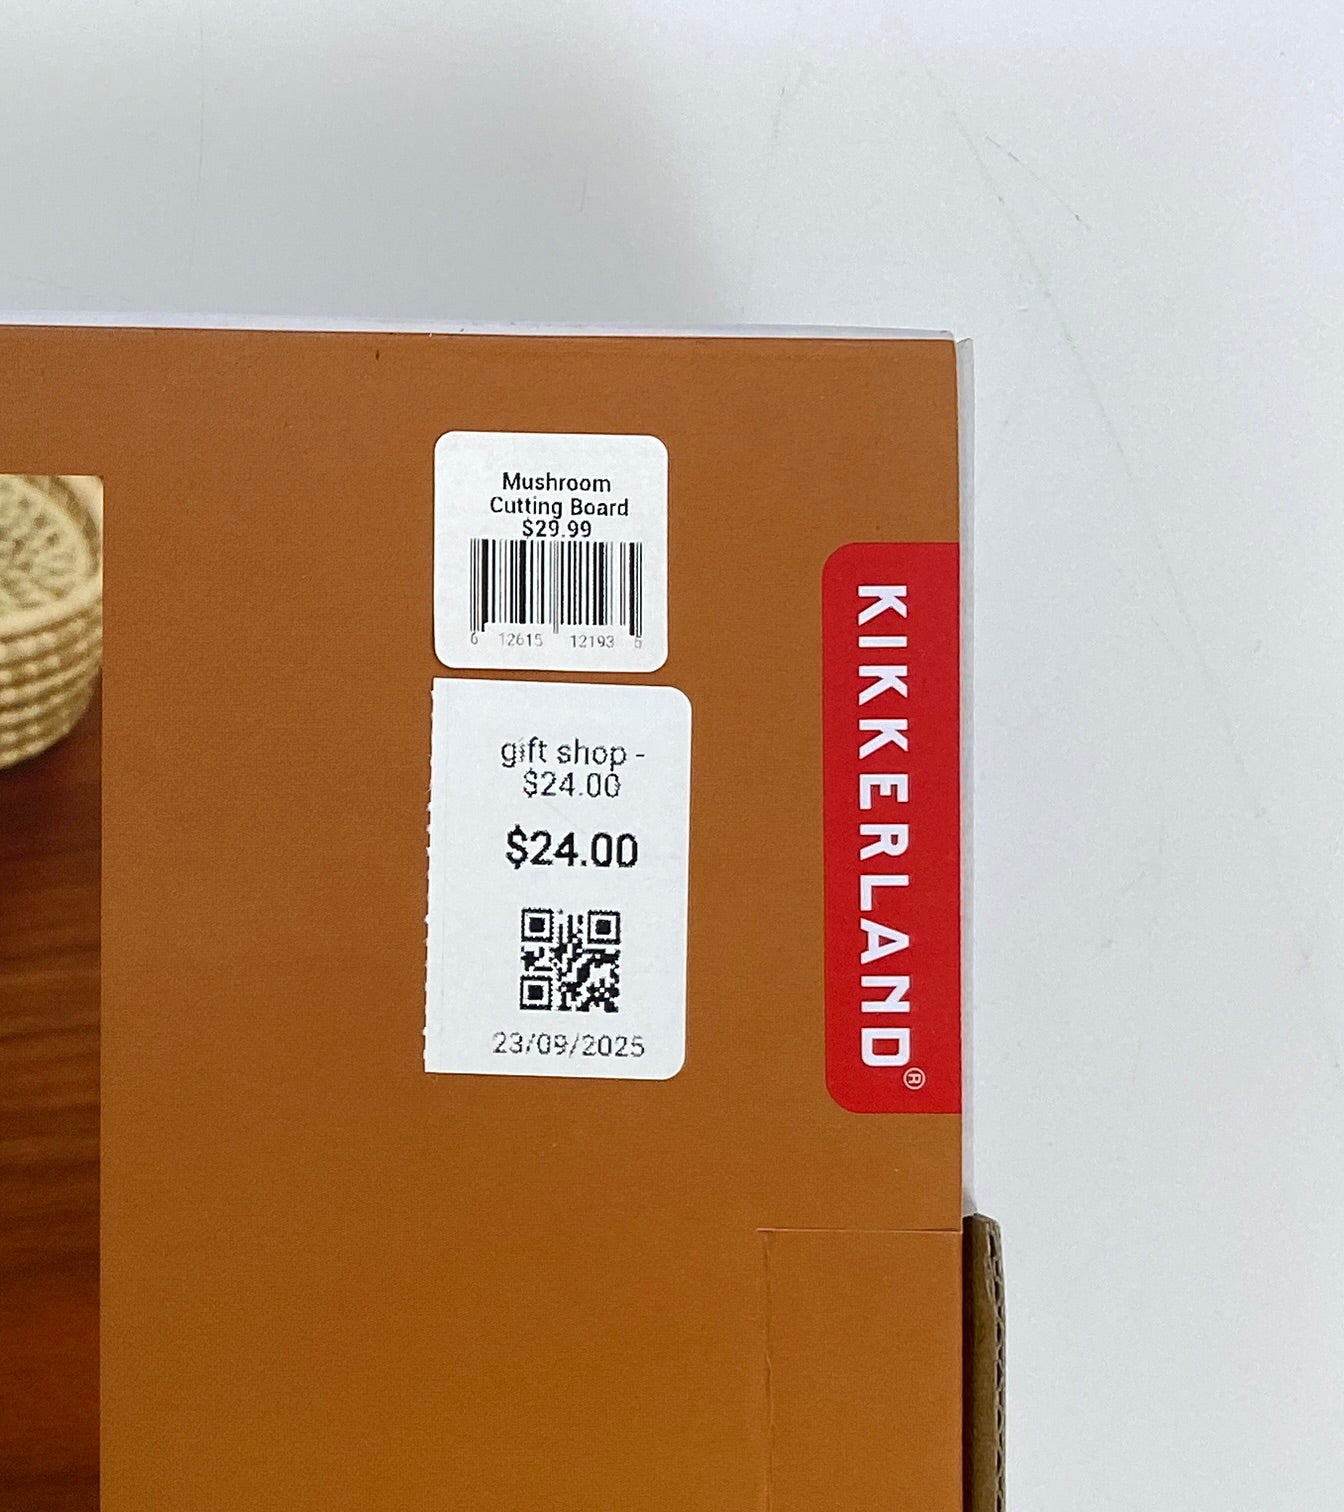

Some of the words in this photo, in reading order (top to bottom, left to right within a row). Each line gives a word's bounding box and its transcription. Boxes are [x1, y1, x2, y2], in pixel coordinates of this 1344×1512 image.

[502, 471, 612, 493] Mushroom
[490, 495, 563, 520] Cutting
[570, 497, 629, 517] Board
[522, 517, 593, 539] $29.99
[470, 631, 479, 645] 6
[499, 633, 544, 647] 12615
[570, 635, 615, 649] 12193
[500, 736, 548, 769] gift
[556, 738, 628, 772] shop
[522, 768, 622, 798] $24.00
[505, 824, 638, 870] $24.00
[492, 1030, 646, 1058] 23/09/2025
